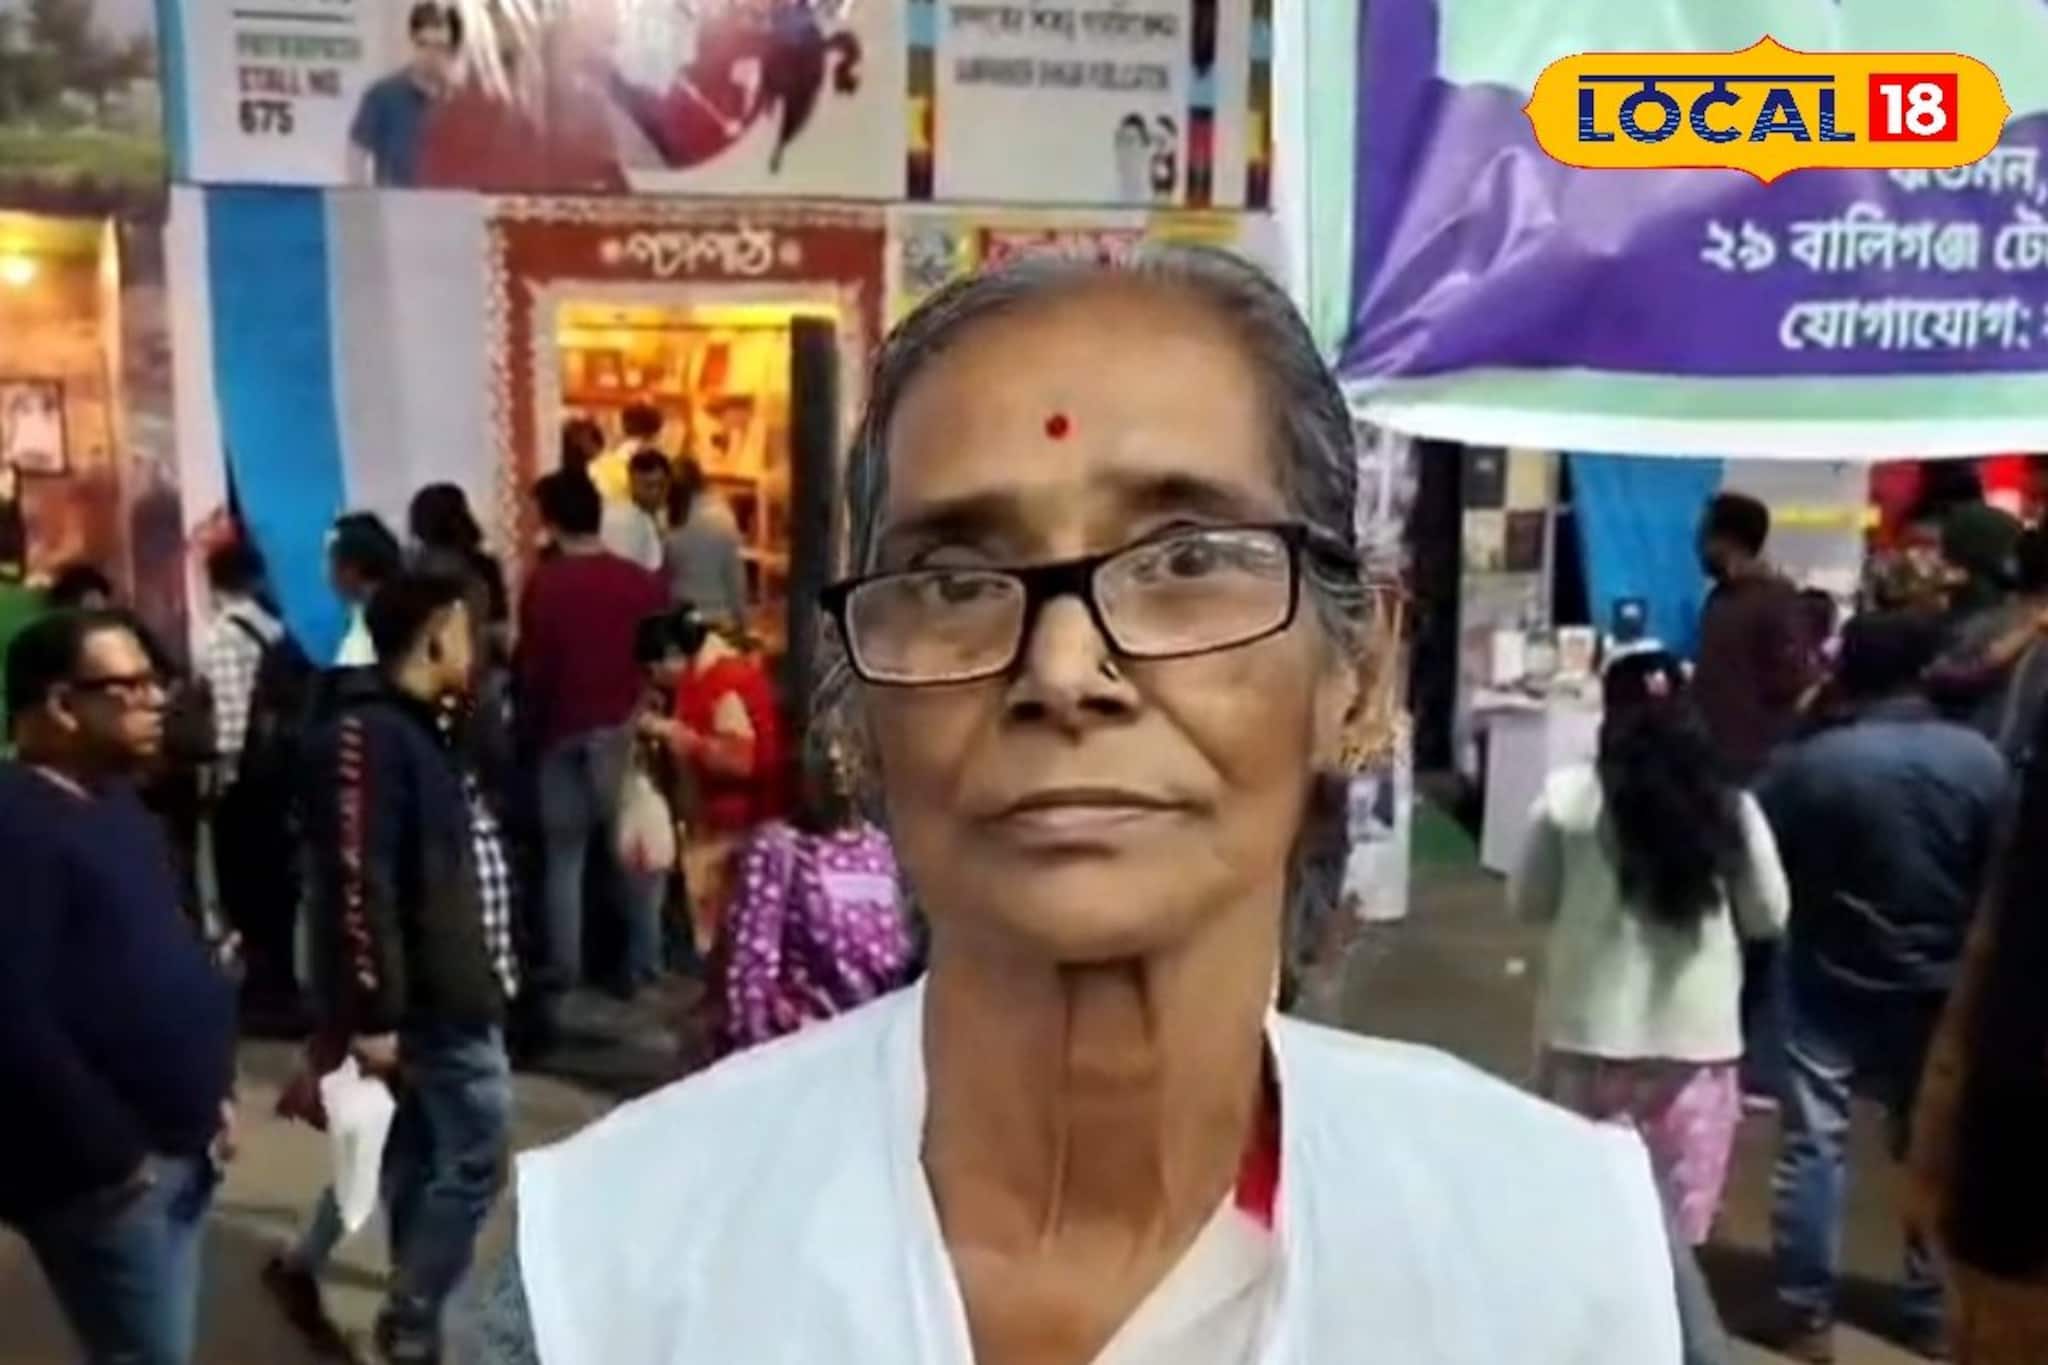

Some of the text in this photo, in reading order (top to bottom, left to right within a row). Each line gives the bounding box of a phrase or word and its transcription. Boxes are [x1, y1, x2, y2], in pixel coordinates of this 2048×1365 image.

[238, 98, 295, 135] 675
[1700, 220, 1777, 271] ২৯
[1789, 201, 1983, 272] বালিগঞ্জ
[1779, 296, 2032, 350] যোগাযোগ:
